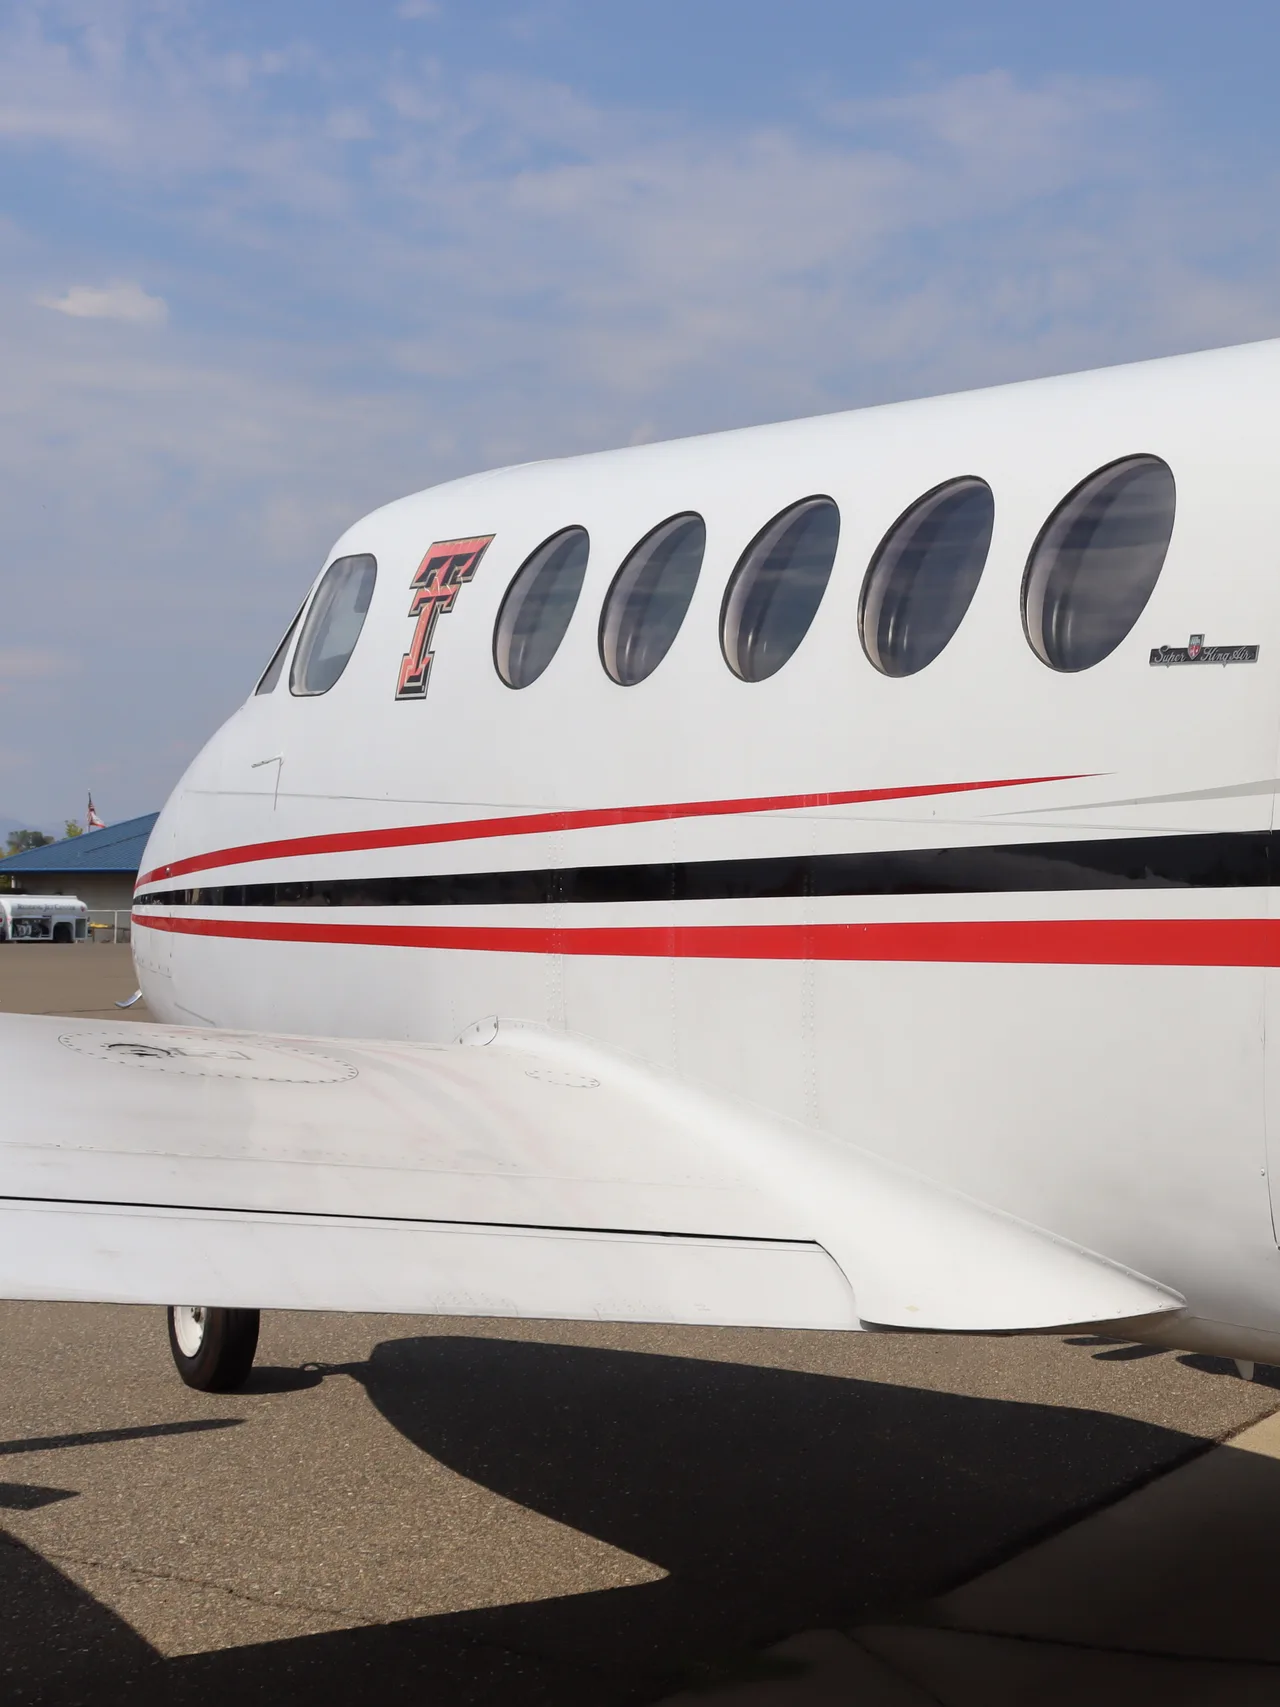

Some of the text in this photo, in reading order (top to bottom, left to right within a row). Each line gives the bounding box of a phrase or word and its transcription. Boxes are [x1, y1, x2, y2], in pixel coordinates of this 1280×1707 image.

[1154, 645, 1252, 663] Super King Air
